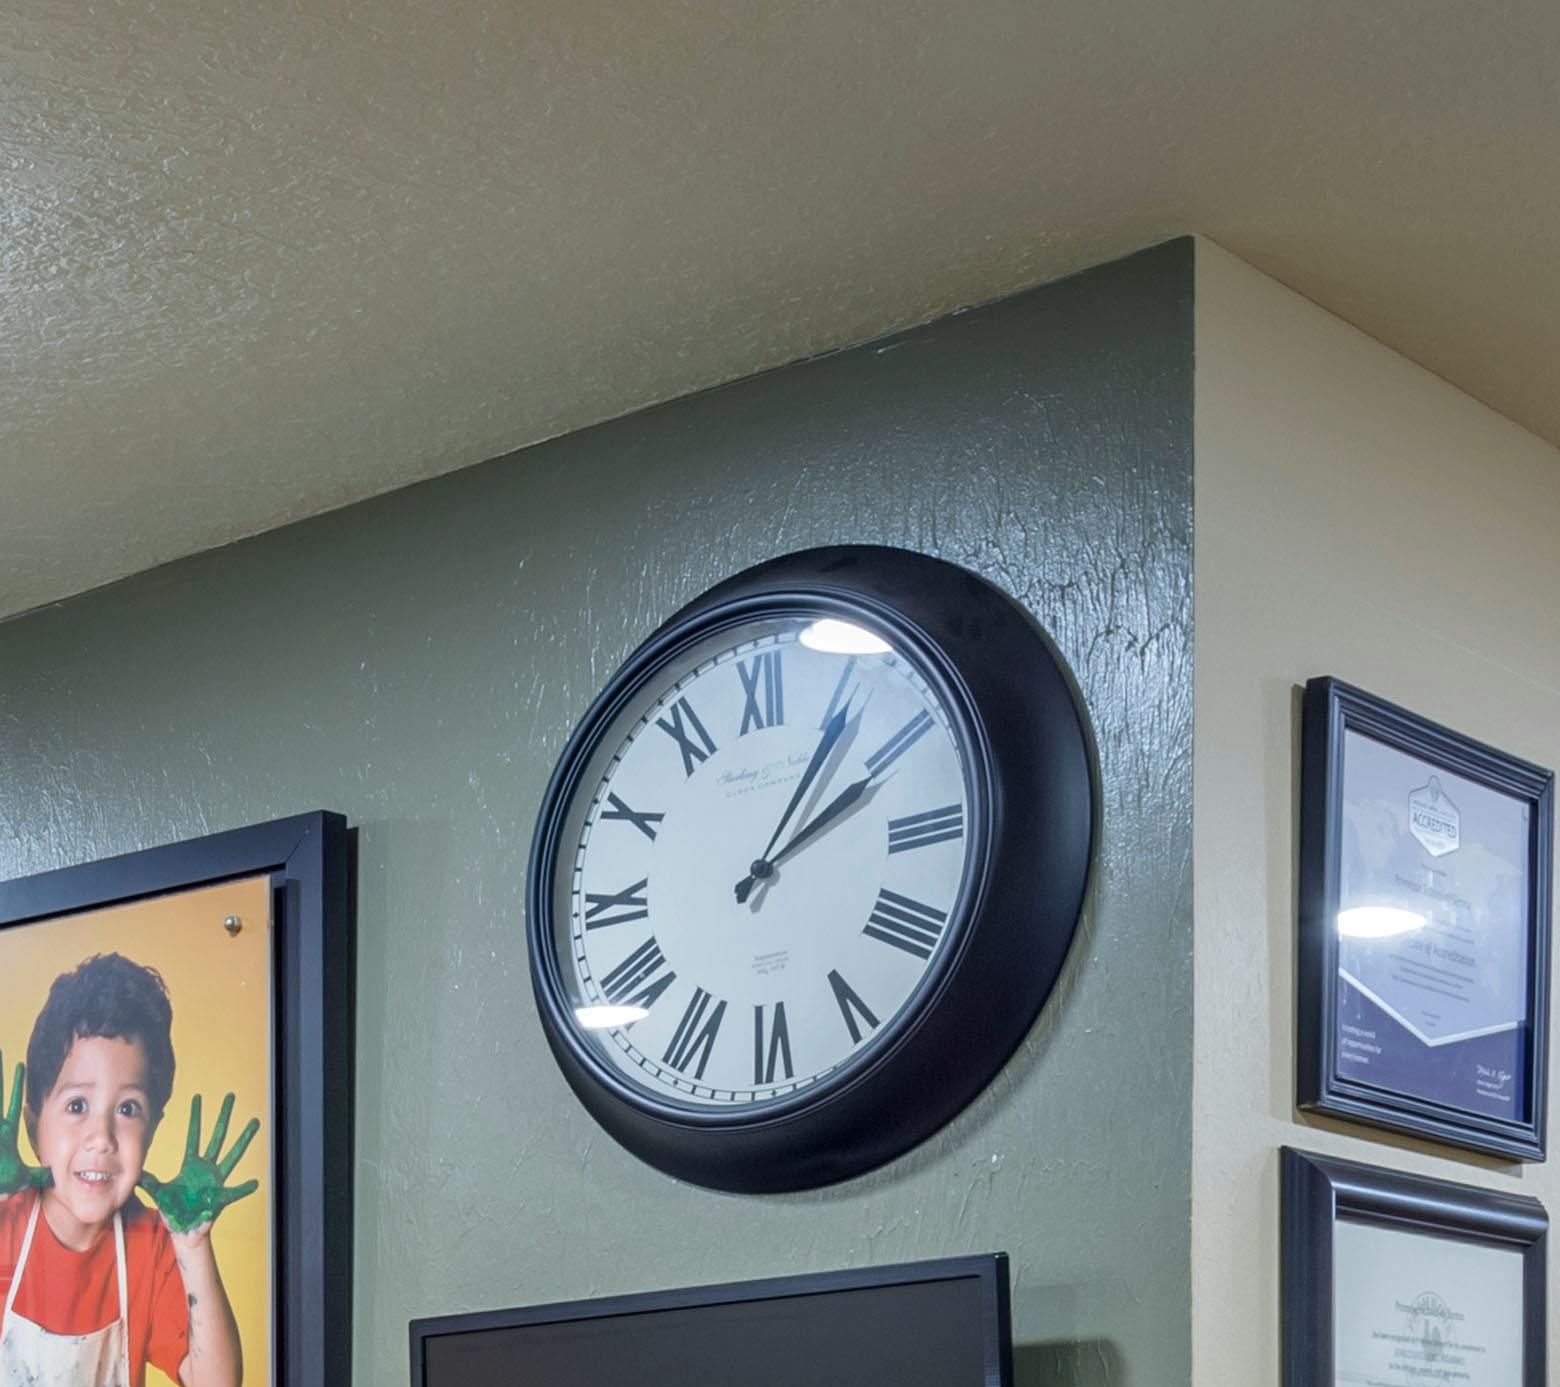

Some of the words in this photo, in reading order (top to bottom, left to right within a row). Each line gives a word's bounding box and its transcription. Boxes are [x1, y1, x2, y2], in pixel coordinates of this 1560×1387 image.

[737, 650, 784, 738] XII
[656, 696, 718, 782] XI
[599, 791, 665, 842] X
[887, 802, 964, 855] III
[661, 985, 728, 1081] VII
[752, 1000, 794, 1086] VI
[827, 968, 882, 1044] V
